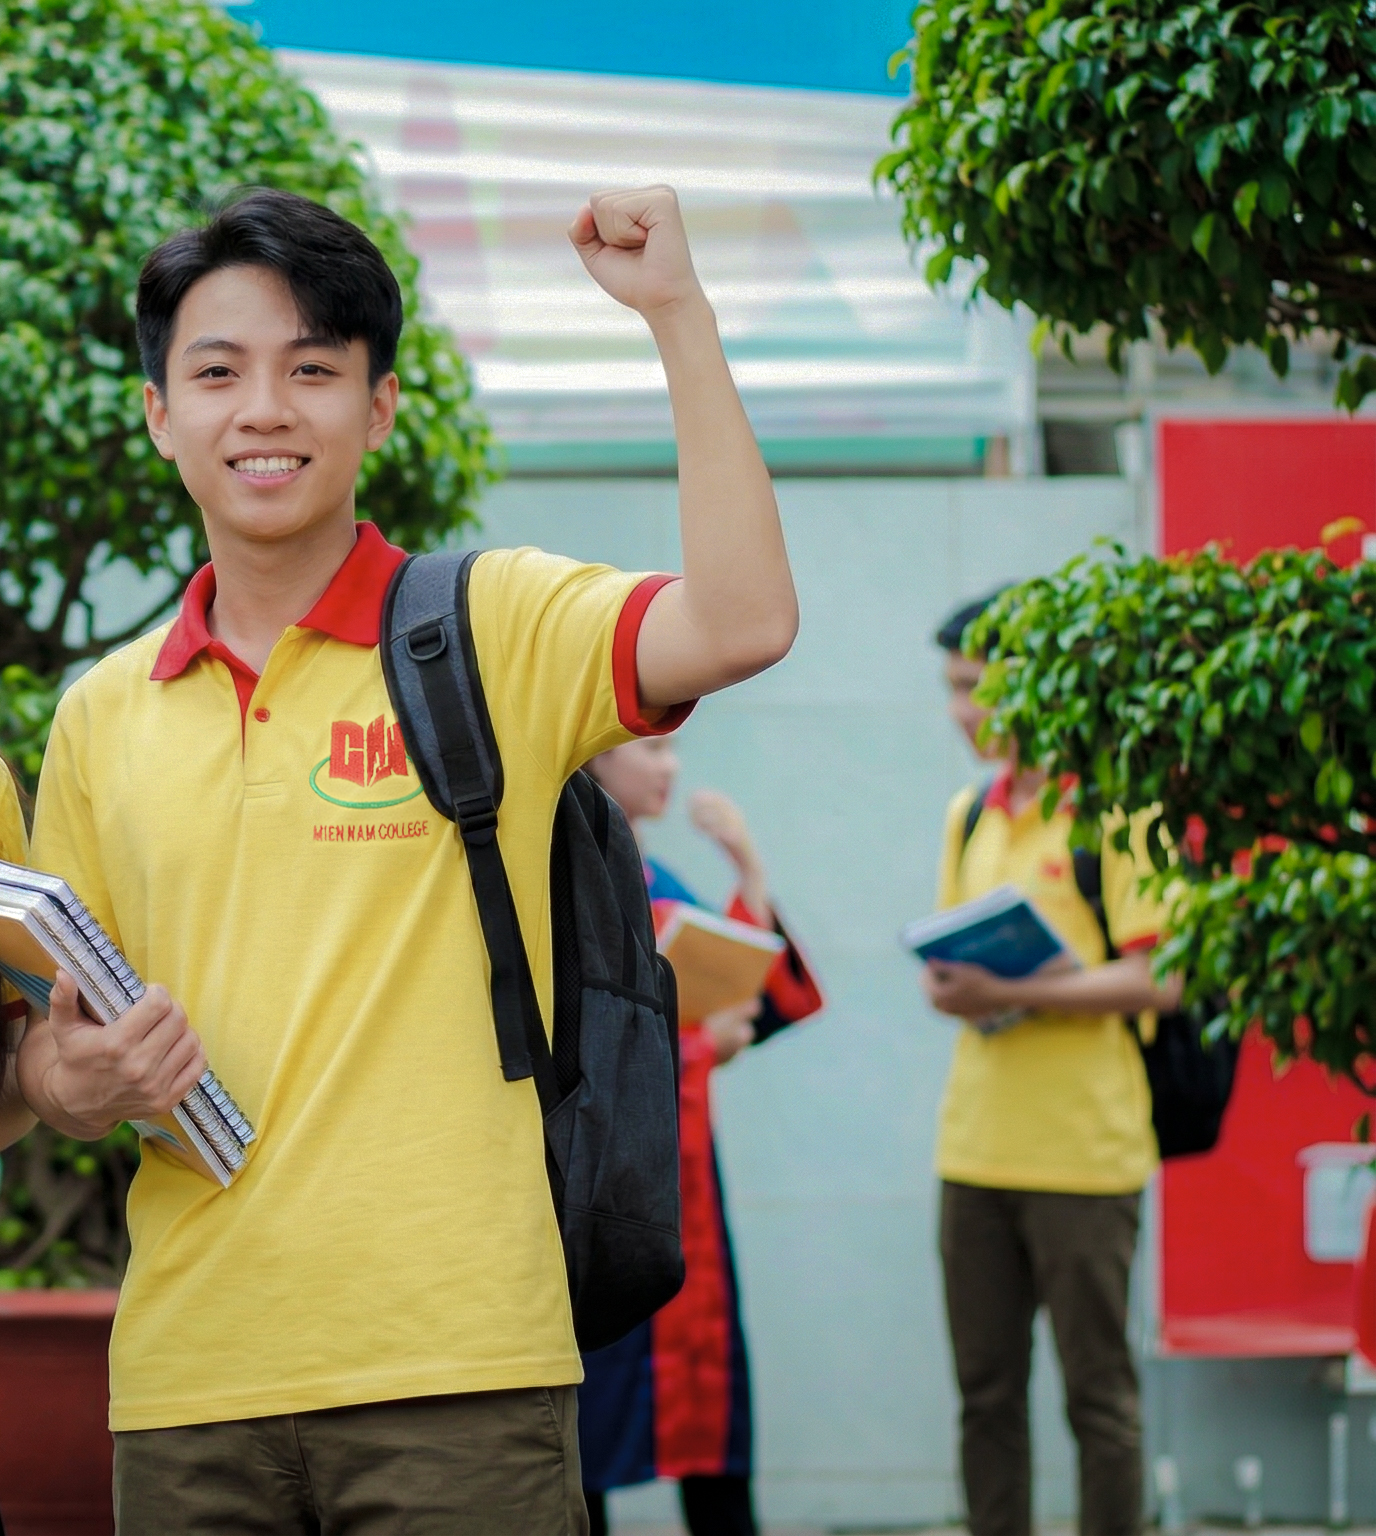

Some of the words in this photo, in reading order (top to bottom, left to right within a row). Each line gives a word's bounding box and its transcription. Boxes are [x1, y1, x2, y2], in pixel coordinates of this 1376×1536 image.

[313, 824, 344, 842] MIEN
[347, 824, 376, 842] NAM
[377, 820, 430, 840] COLLEGE
